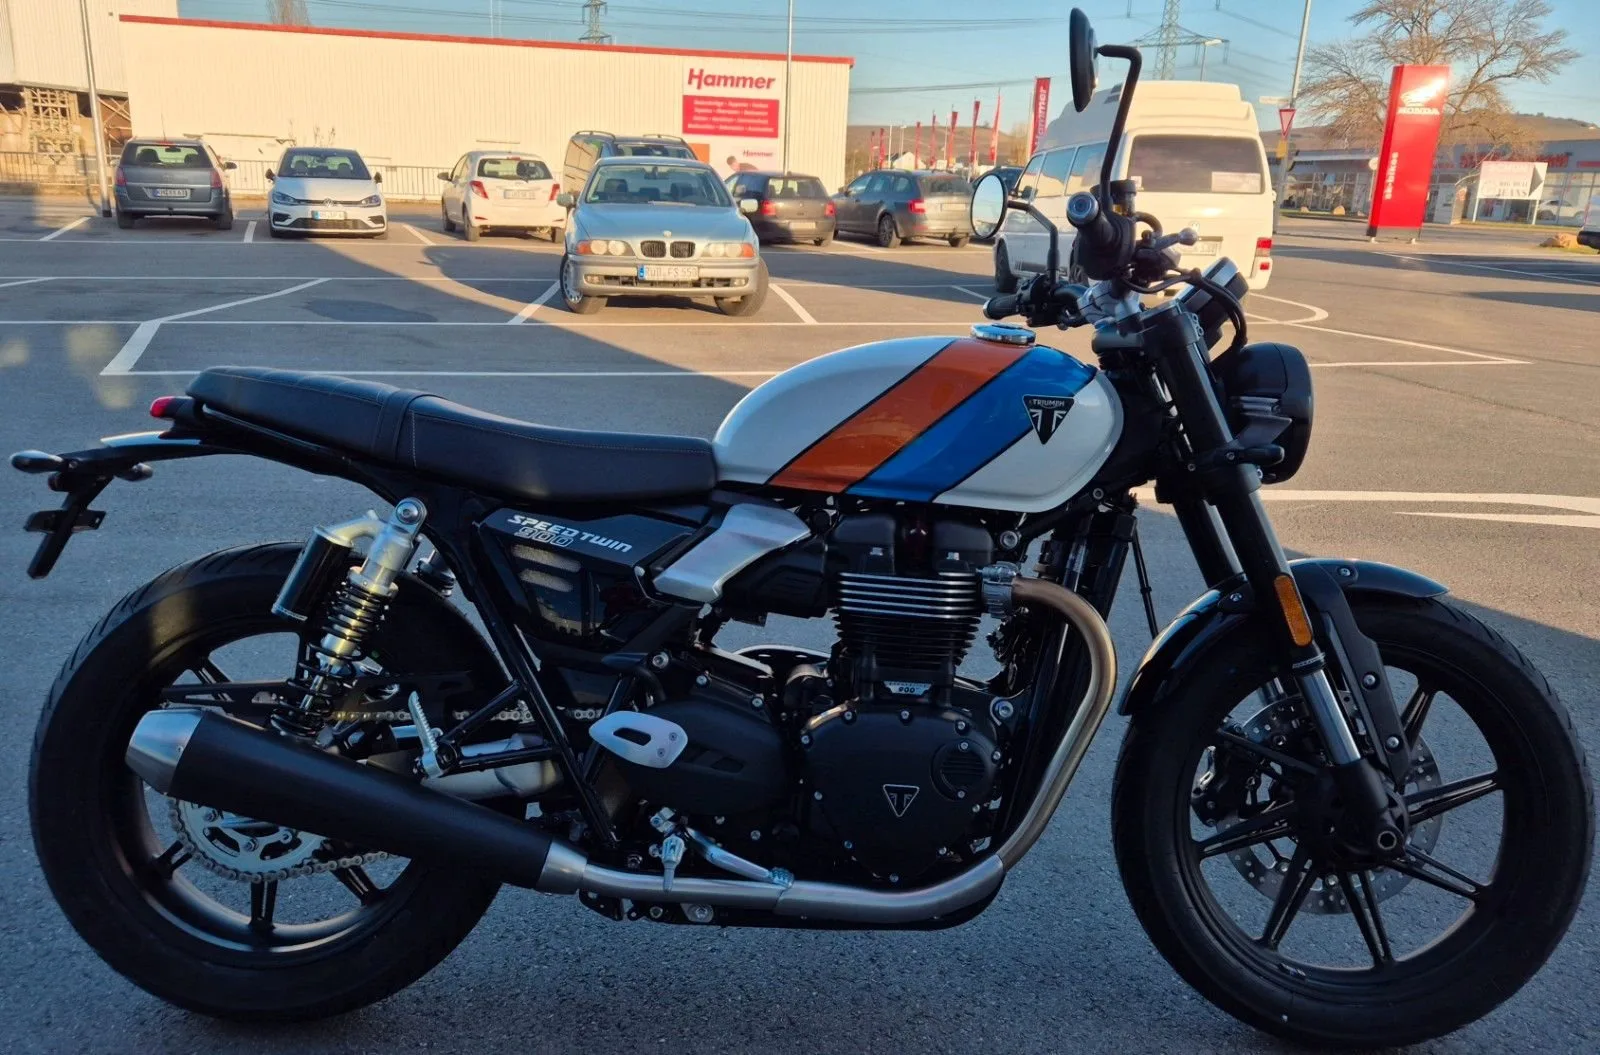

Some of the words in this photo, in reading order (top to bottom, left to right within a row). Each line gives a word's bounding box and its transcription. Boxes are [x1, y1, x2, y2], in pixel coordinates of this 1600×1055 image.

[687, 68, 776, 90] Hammer
[1397, 107, 1440, 115] HONDA
[1384, 151, 1399, 200] sk-bikes
[1032, 398, 1065, 408] TRIUMPH
[507, 514, 579, 537] SPEED
[579, 532, 633, 552] TWIN
[513, 526, 574, 547] 900
